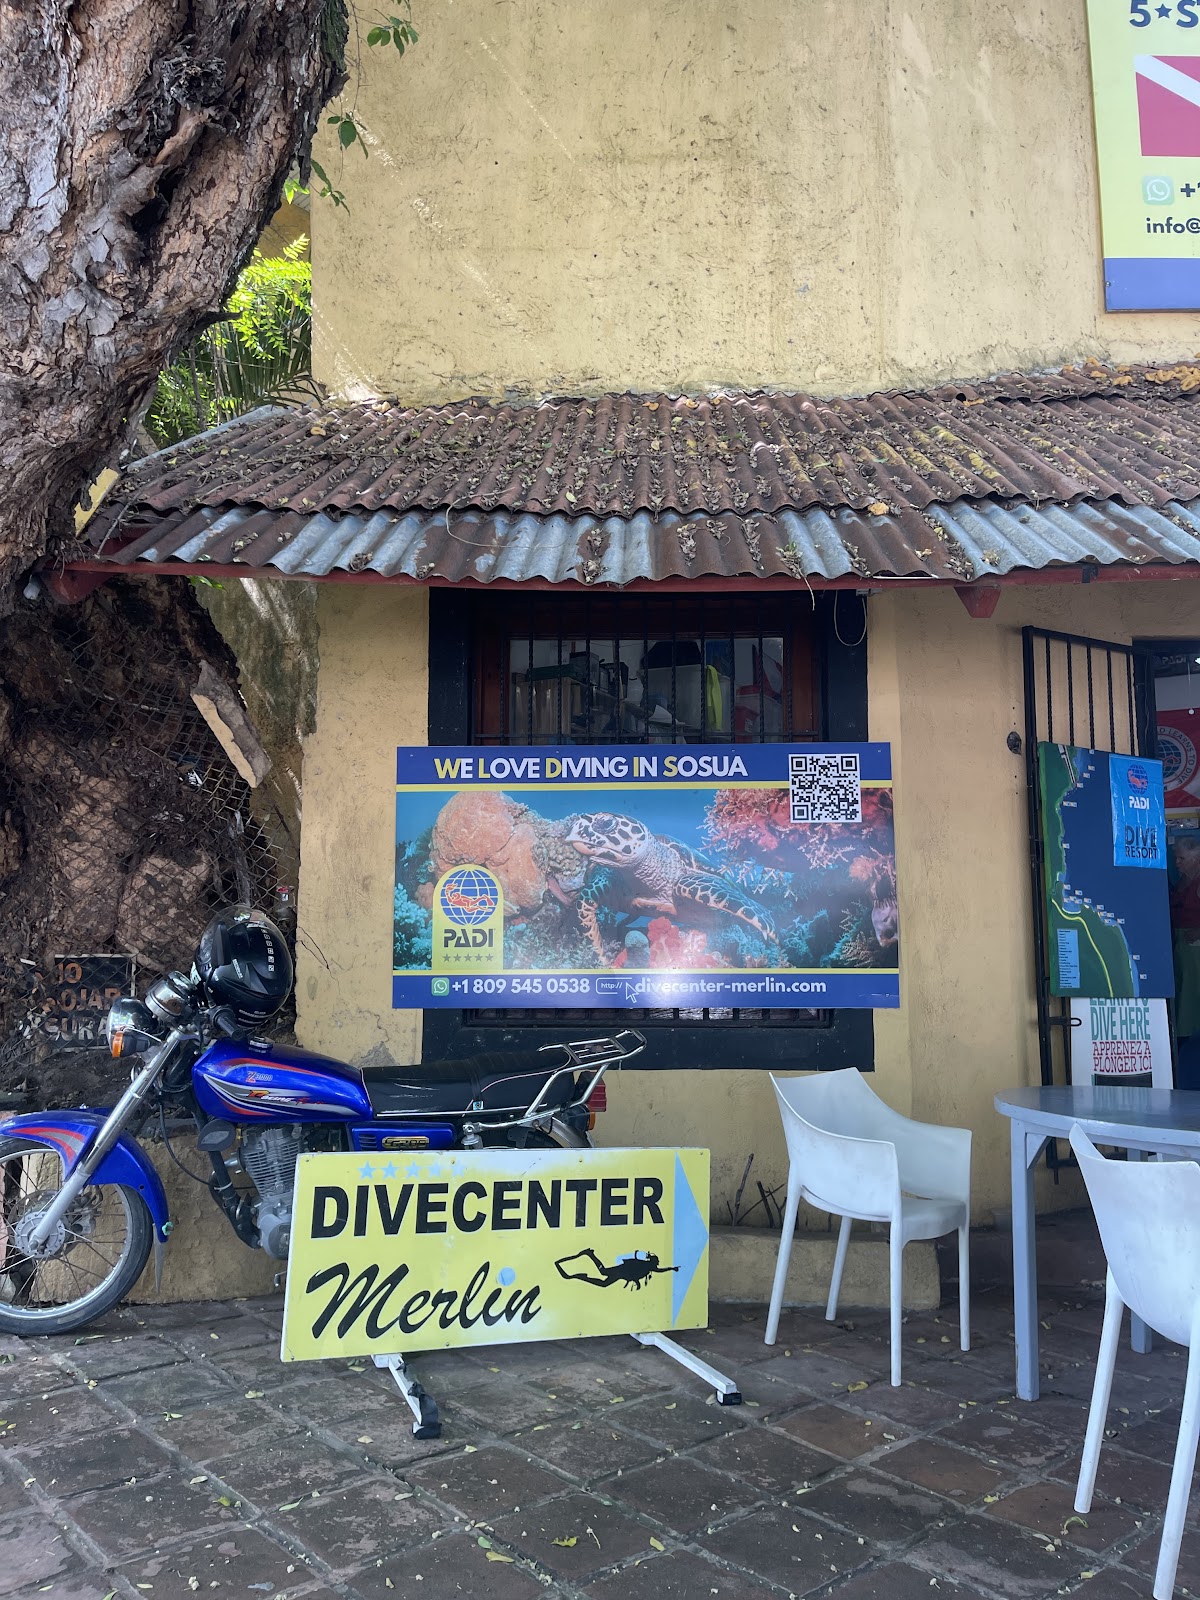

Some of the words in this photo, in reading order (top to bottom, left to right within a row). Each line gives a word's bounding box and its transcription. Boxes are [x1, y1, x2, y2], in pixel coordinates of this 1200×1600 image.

[1176, 0, 1200, 28] S
[1168, 728, 1194, 753] LEARNS
[434, 758, 473, 779] WE
[478, 757, 540, 779] LOVE
[545, 756, 628, 778] DIVING
[633, 756, 657, 777] IN
[663, 755, 748, 777] SOSUA
[1177, 767, 1193, 785] DIVE
[1128, 795, 1150, 810] PADI
[1125, 825, 1157, 848] DIVE
[1125, 845, 1158, 860] RESORT
[443, 928, 494, 948] PADI
[452, 979, 469, 994] +1
[472, 978, 507, 994] 809
[510, 978, 543, 994] 545
[546, 978, 591, 994] 0538
[600, 982, 623, 990] http://
[635, 976, 828, 994] divecenter-merlin.com
[1090, 1006, 1118, 1040] DIVE
[1119, 1006, 1151, 1040] HERE
[1092, 1041, 1143, 1056] APPRENEZ
[1143, 1040, 1152, 1055] A
[1093, 1055, 1137, 1073] PLONGER
[1139, 1055, 1152, 1071] ICI
[310, 1177, 665, 1239] DIVECENTER
[306, 1261, 542, 1340] Merlin
